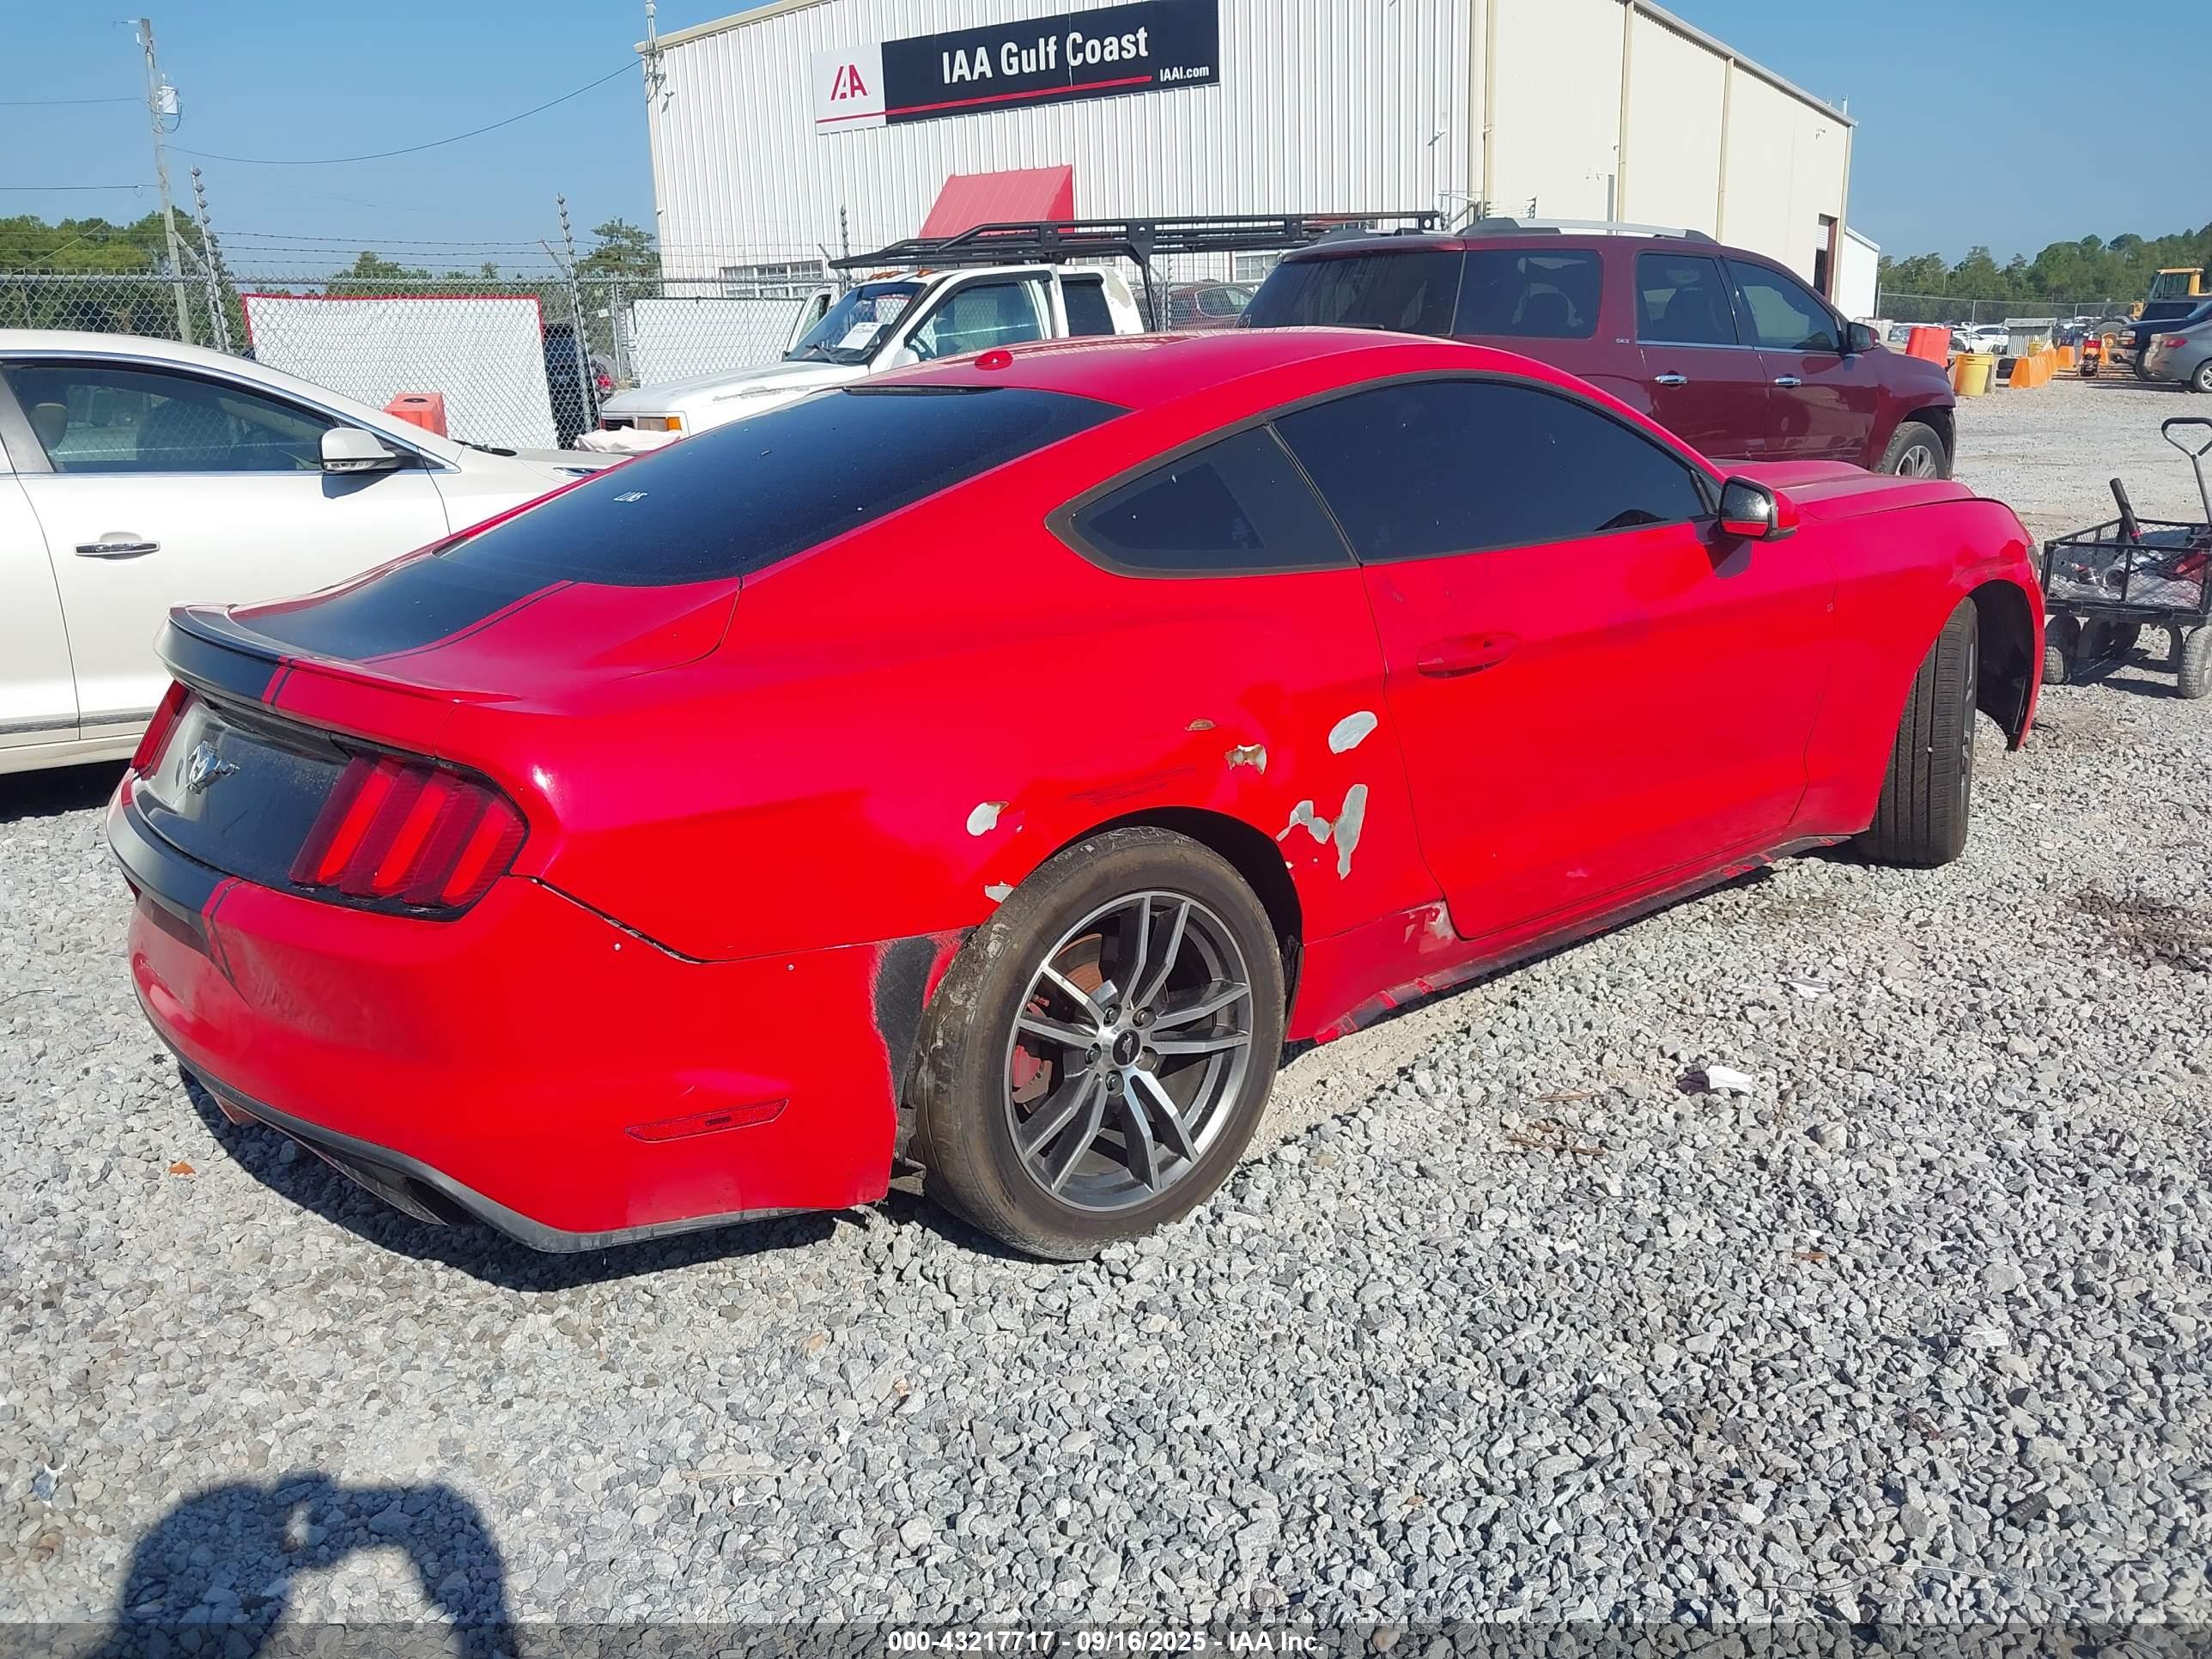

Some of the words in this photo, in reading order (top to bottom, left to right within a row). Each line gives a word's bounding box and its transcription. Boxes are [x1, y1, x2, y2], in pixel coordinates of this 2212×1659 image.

[942, 46, 993, 84] IAA
[1000, 35, 1057, 76] Gulf
[1066, 26, 1149, 67] Coast
[1159, 65, 1210, 82] IAAI.com
